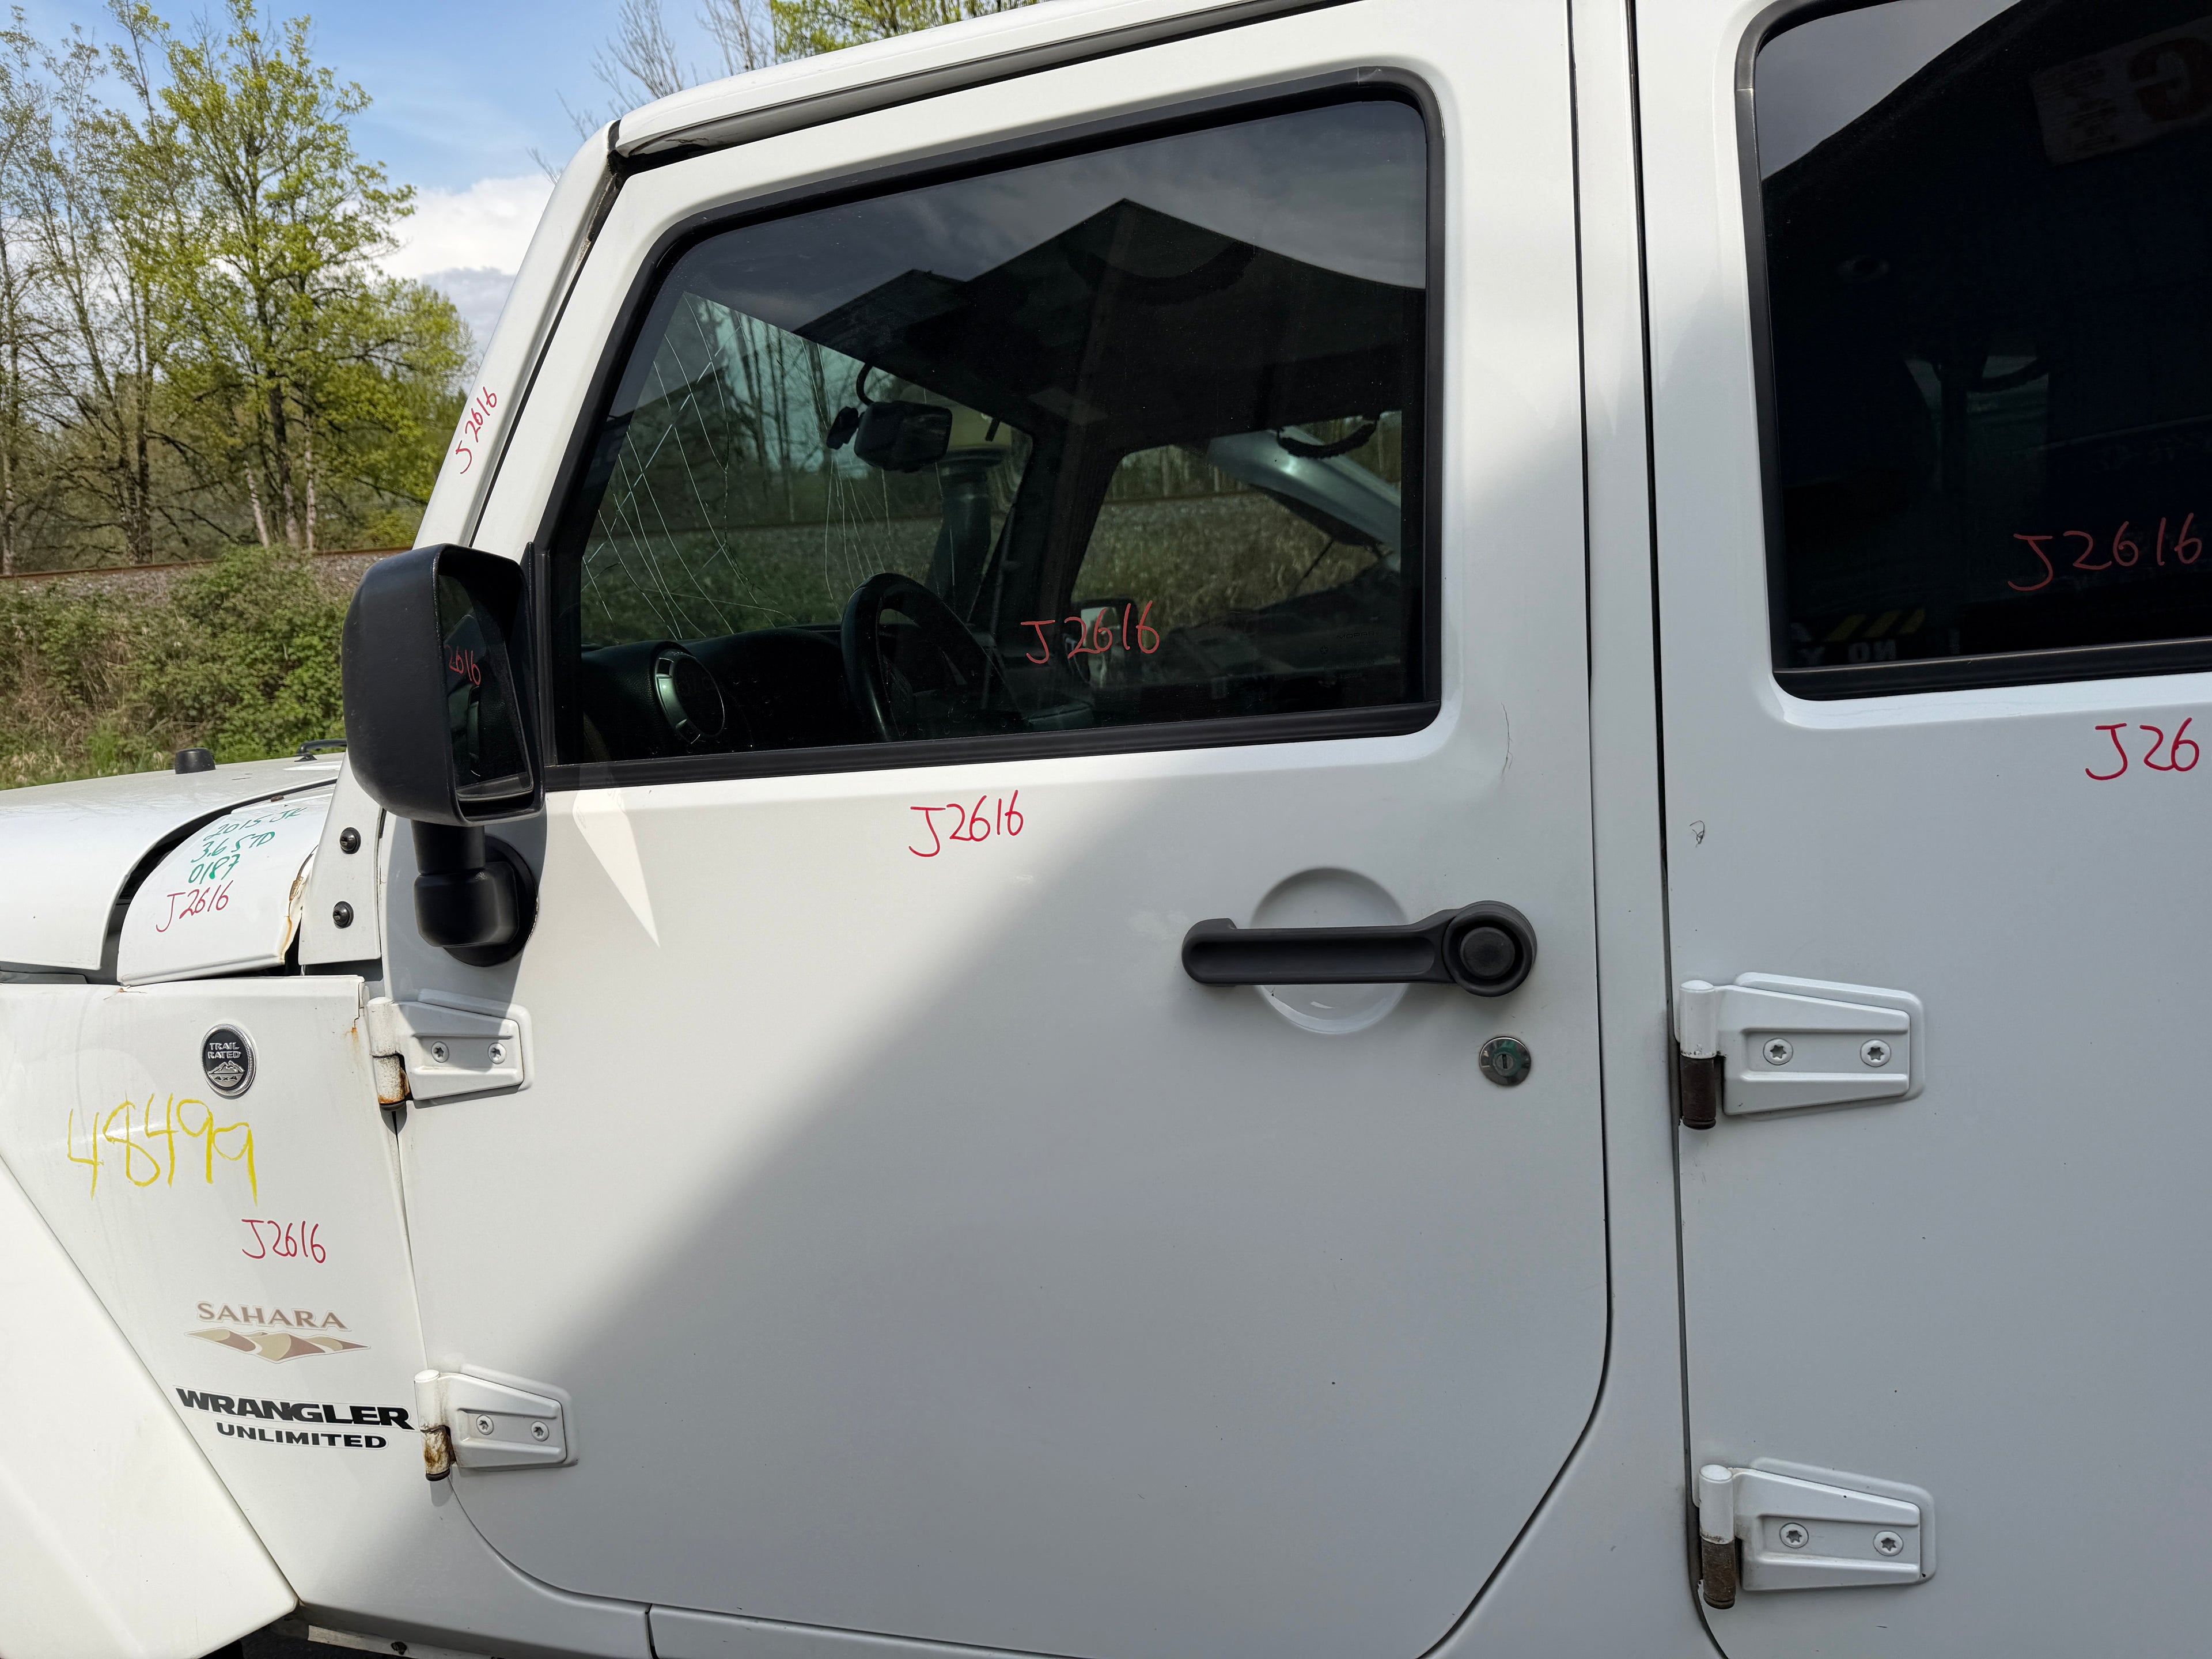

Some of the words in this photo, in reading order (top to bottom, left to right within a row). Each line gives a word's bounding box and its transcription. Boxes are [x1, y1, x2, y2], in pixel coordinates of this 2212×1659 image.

[2008, 513, 2202, 591] J2616
[1021, 600, 1160, 664] J2616
[2085, 717, 2200, 781] J26
[203, 813, 273, 841] 2015
[909, 790, 1024, 857] J2616
[188, 854, 240, 884] 0187
[156, 880, 233, 932] J2616
[207, 1051, 241, 1059] RATED
[209, 1041, 240, 1050] TRAIL
[67, 1093, 258, 1206] 48499
[241, 1219, 326, 1264] J2616
[197, 1302, 349, 1330] SAHARA
[175, 1387, 415, 1431] WRANGLER
[216, 1422, 387, 1449] UNLIMITED
